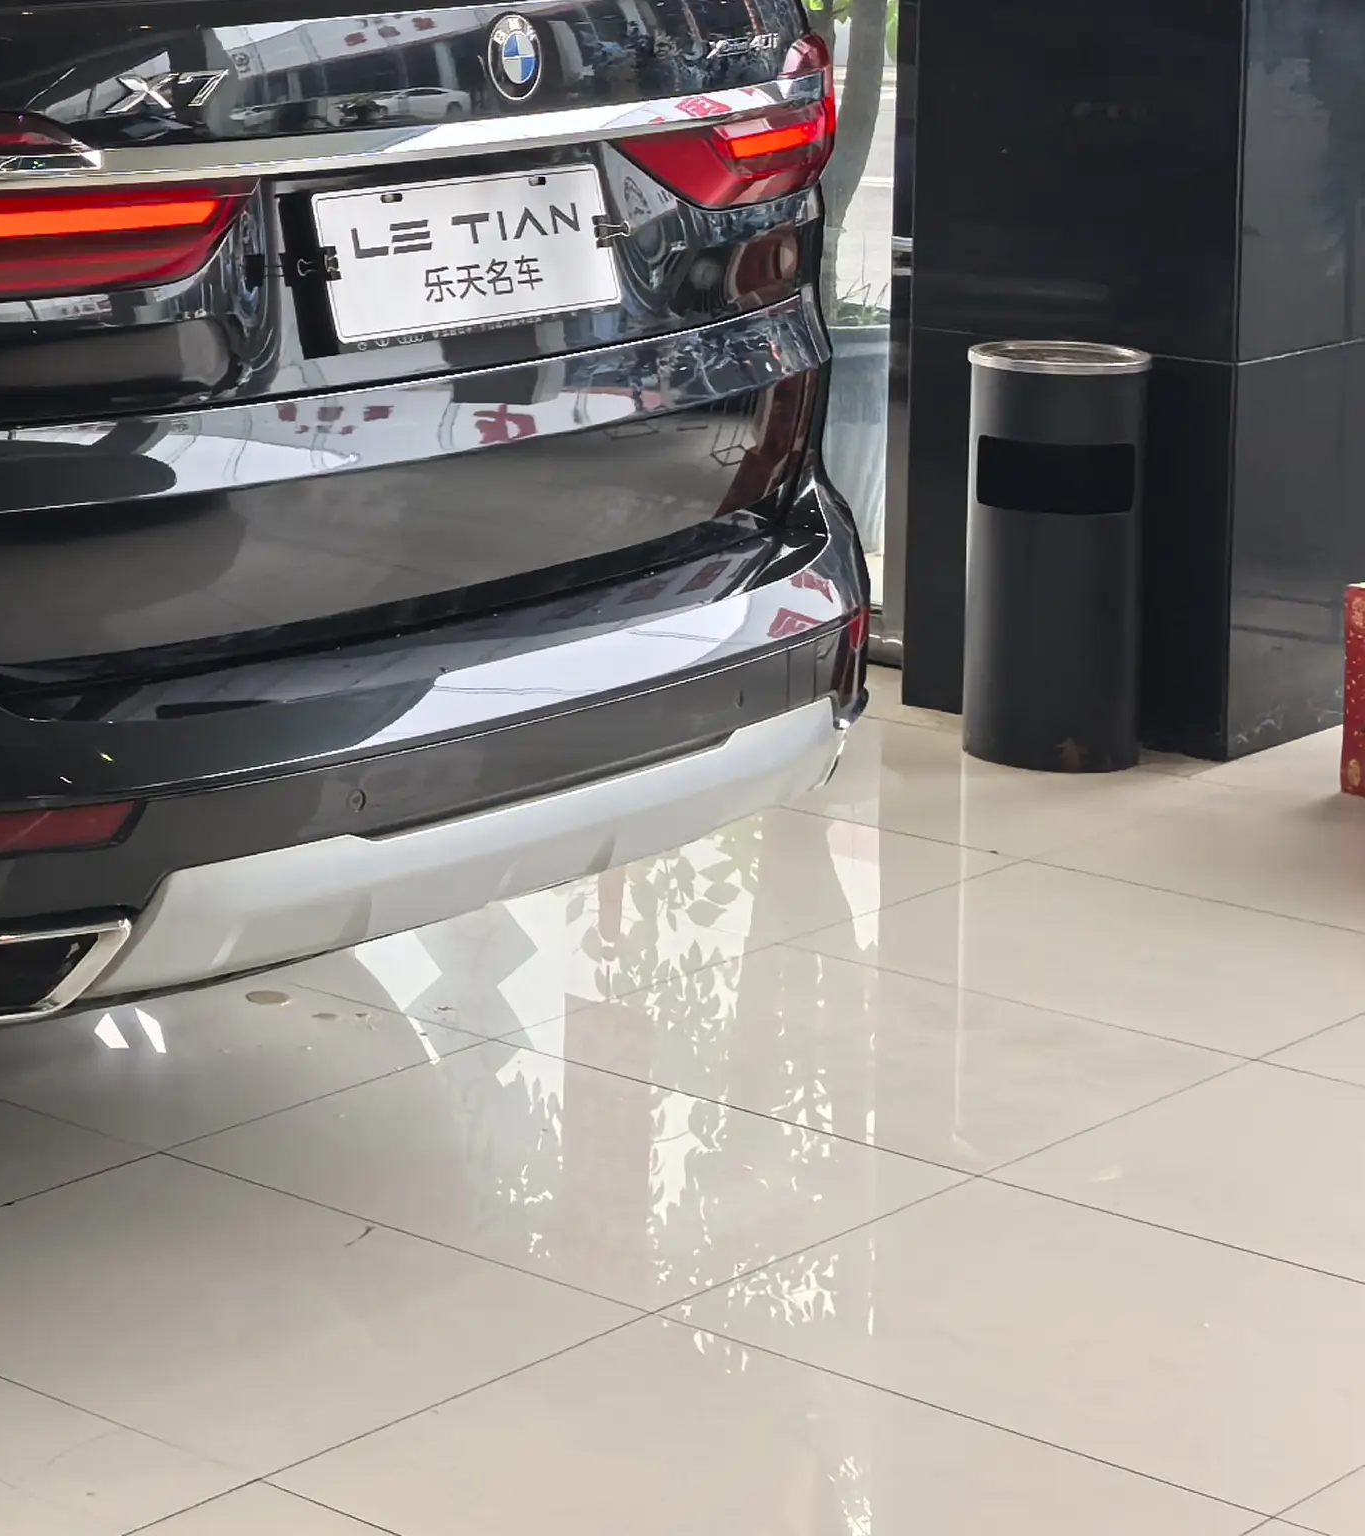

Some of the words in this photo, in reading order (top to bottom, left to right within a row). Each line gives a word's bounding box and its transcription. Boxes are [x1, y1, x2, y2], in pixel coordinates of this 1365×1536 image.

[105, 69, 229, 114] X7
[351, 219, 432, 259] LE
[451, 202, 581, 244] TIAN
[425, 255, 544, 303] 乐天名车
